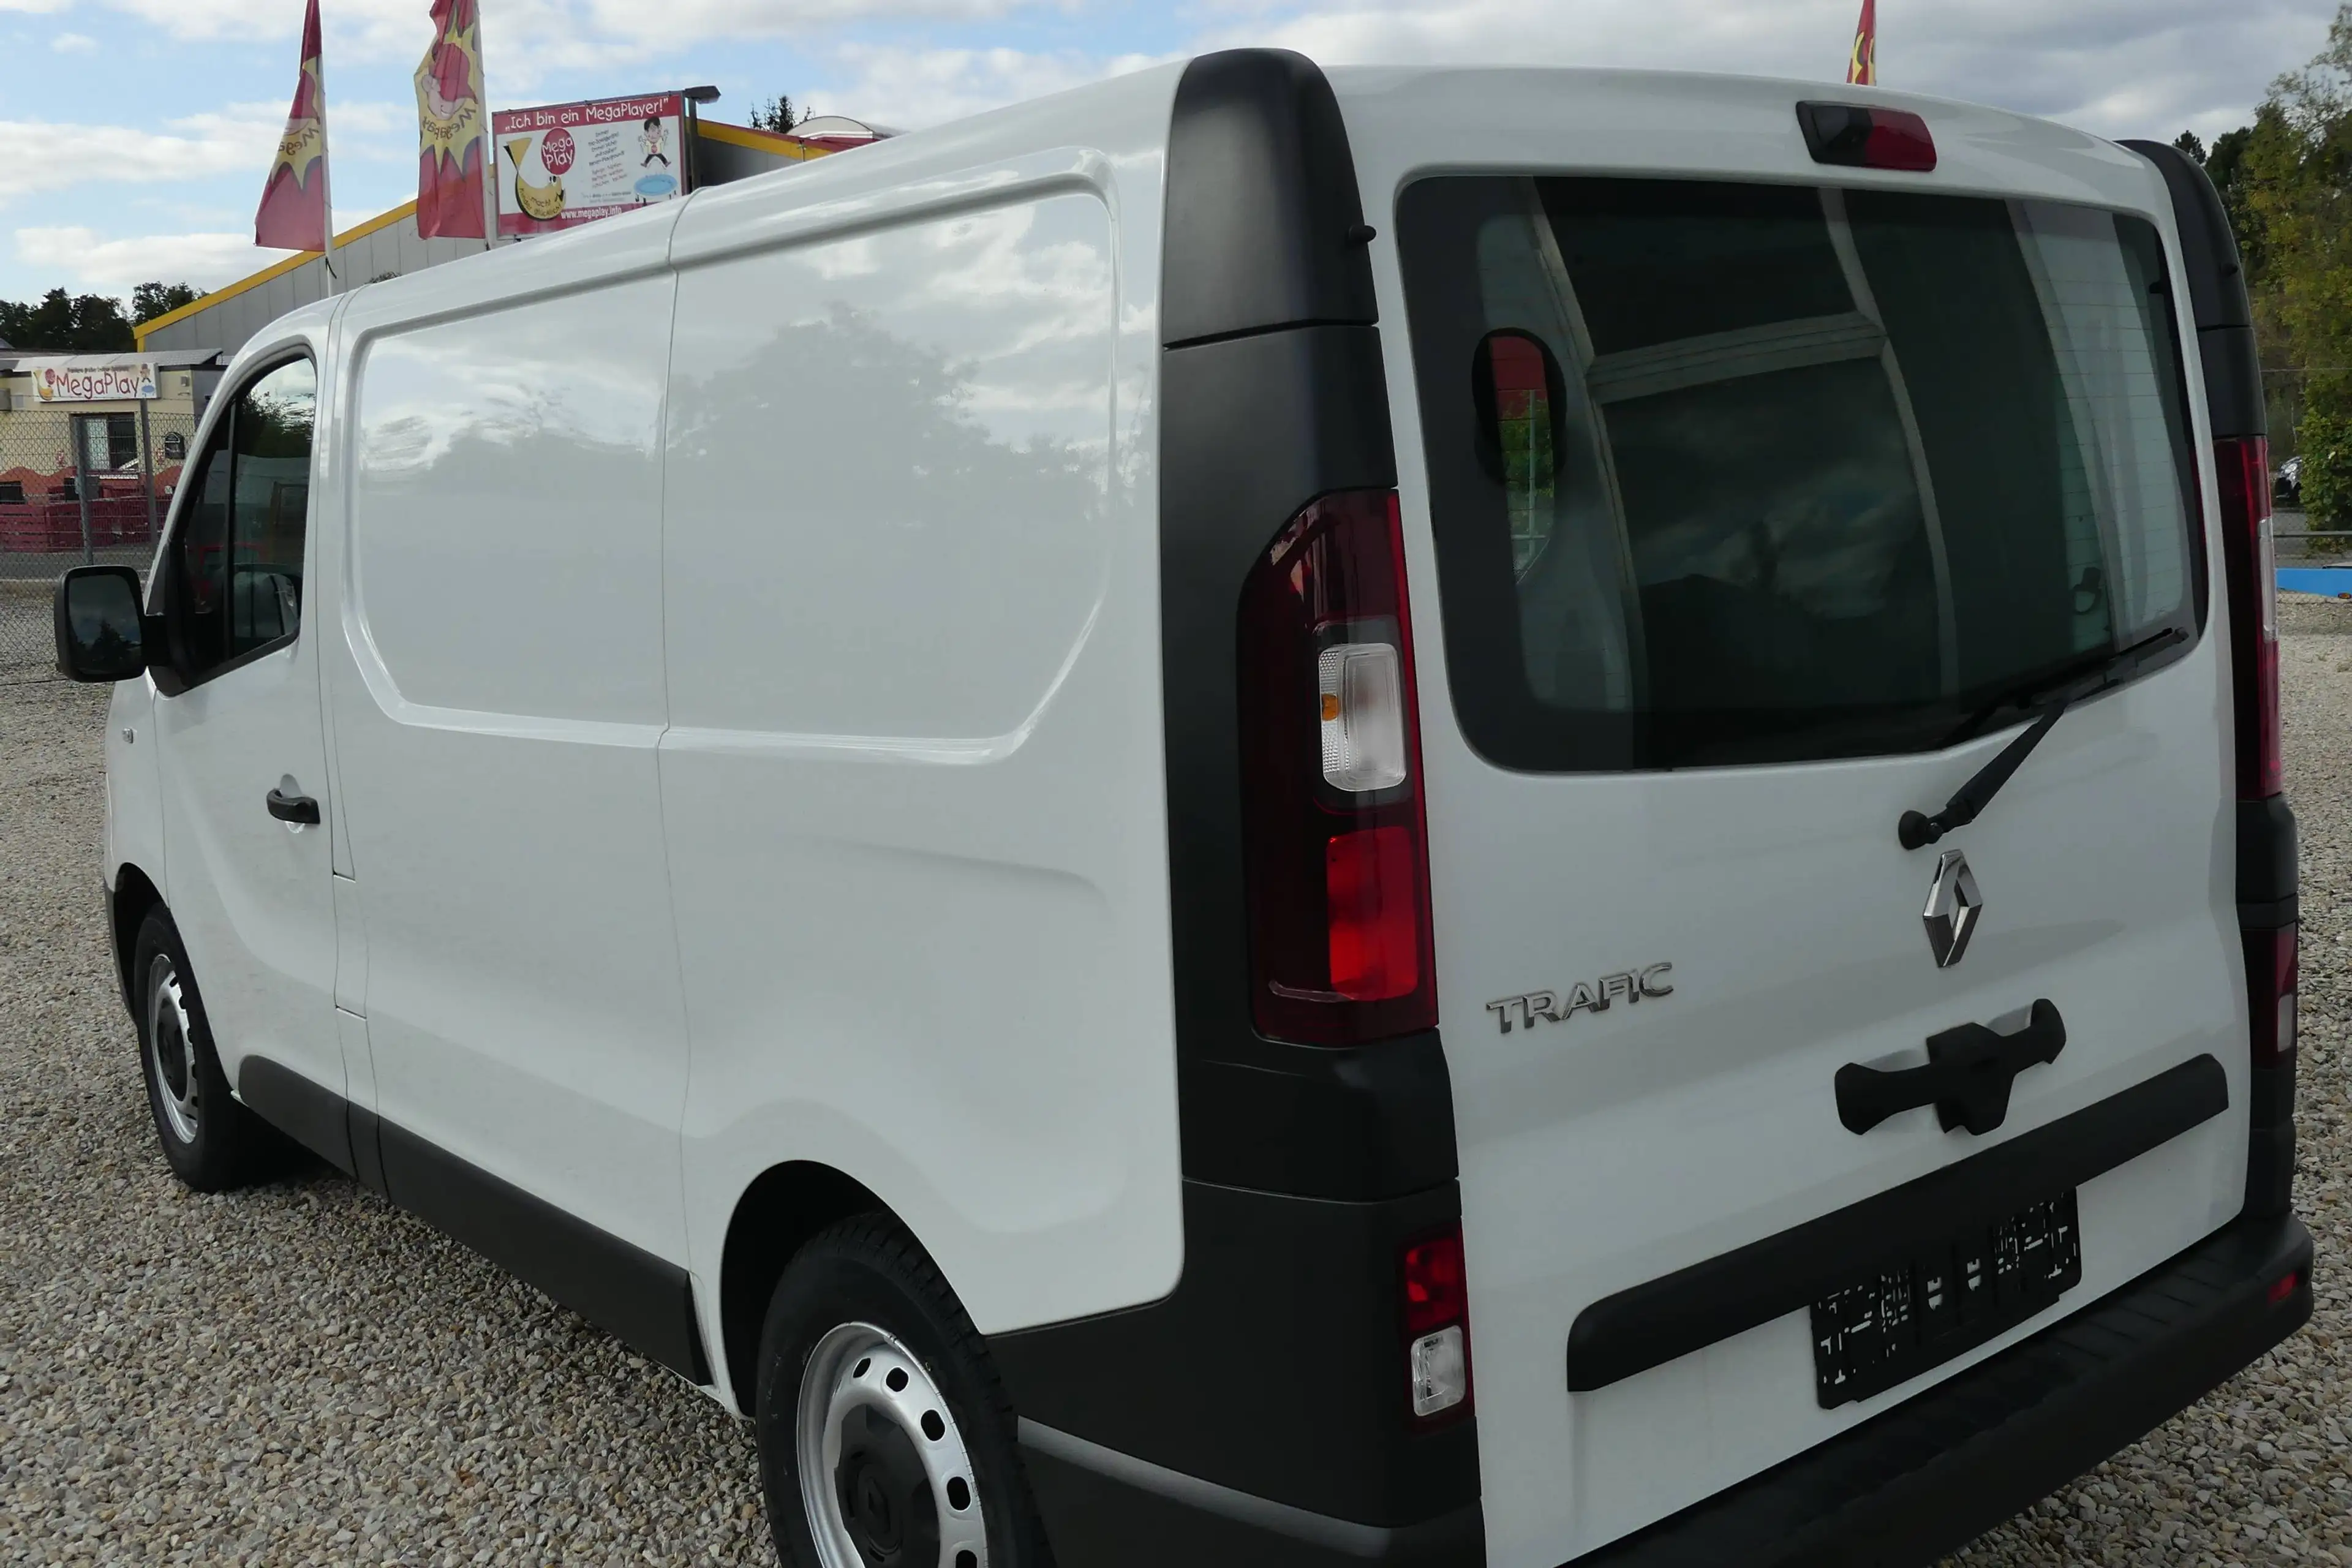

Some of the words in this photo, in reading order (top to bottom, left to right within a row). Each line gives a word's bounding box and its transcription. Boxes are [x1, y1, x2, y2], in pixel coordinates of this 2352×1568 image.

[537, 111, 556, 126] bin
[561, 109, 579, 124] ein
[541, 137, 574, 157] Mega
[560, 205, 622, 220] www.megaplay.info
[56, 371, 140, 399] MegaPlay
[1486, 962, 1674, 1034] TRAFIC
